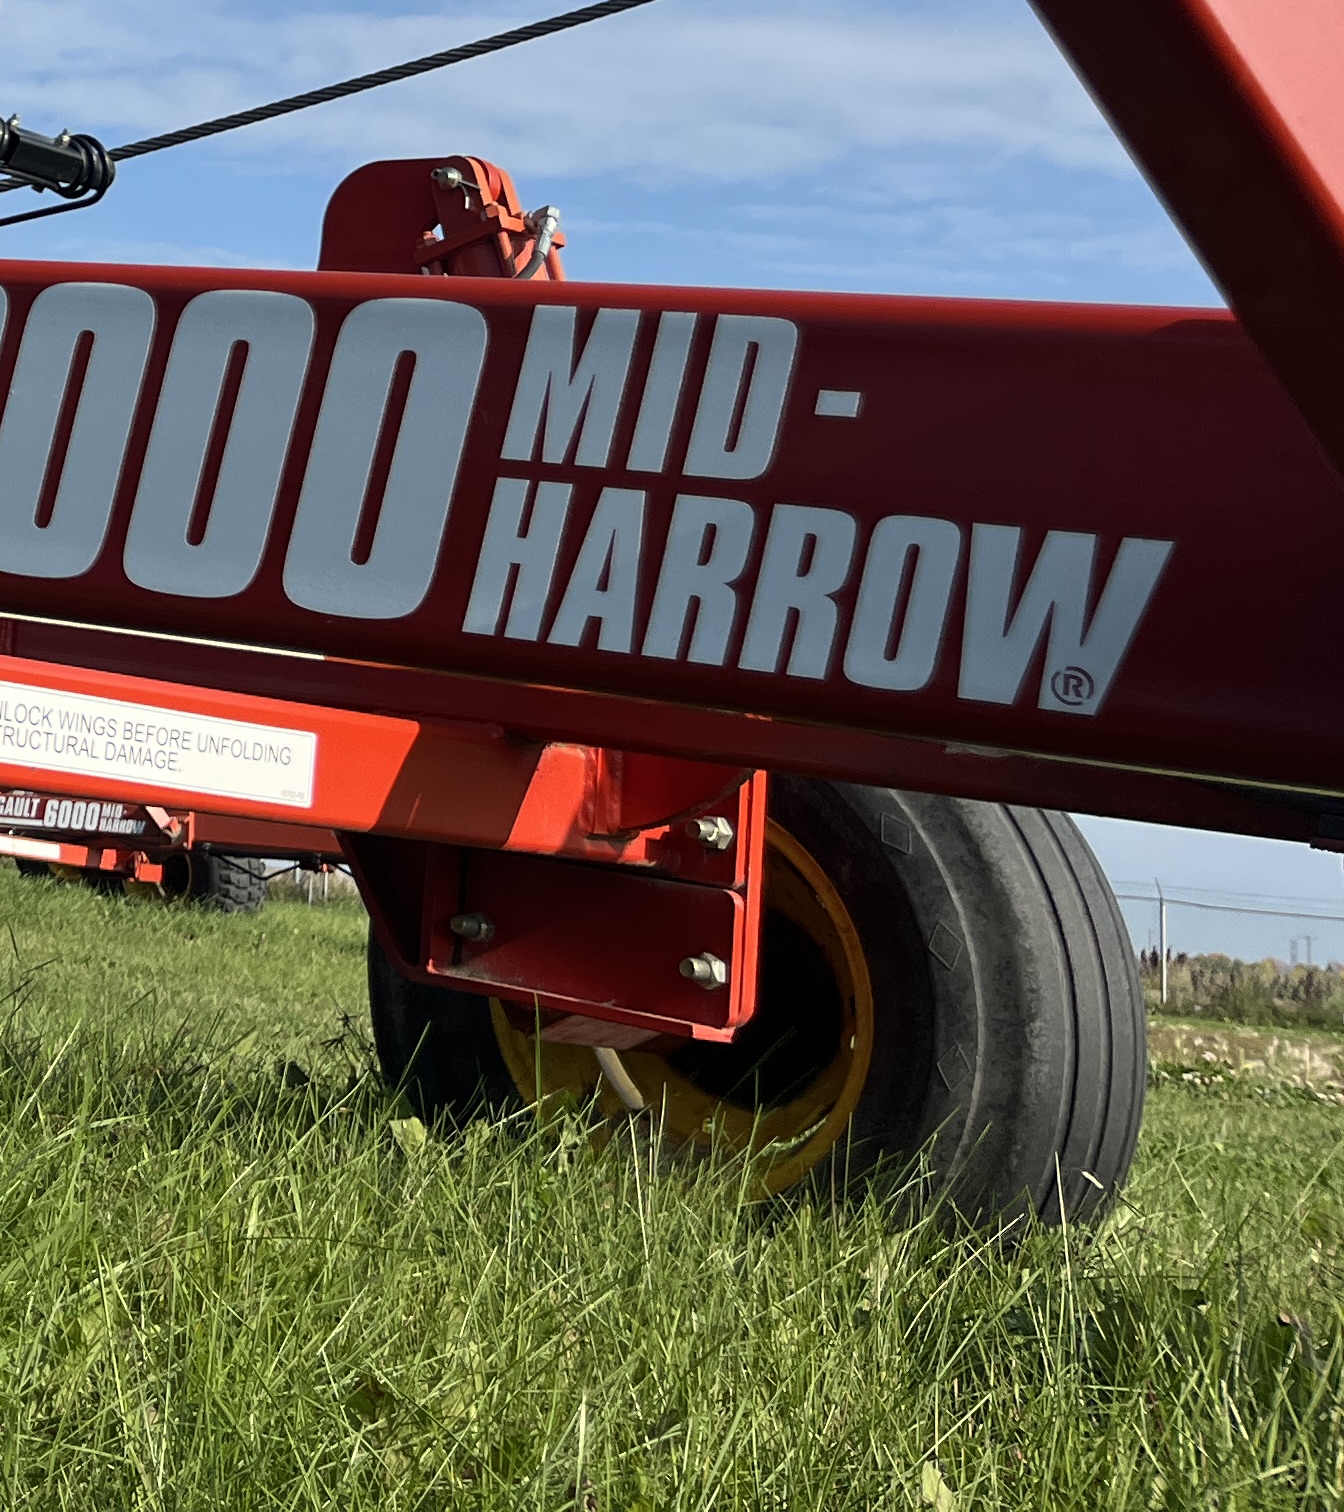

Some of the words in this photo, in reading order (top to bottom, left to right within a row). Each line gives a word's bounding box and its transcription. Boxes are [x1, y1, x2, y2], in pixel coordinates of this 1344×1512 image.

[500, 304, 861, 481] MID-
[58, 710, 118, 737] WINGS
[122, 721, 194, 750] BEFORE
[197, 732, 291, 766] UNFOLDING
[104, 741, 182, 772] DAMAGE.
[43, 799, 101, 831] 6000
